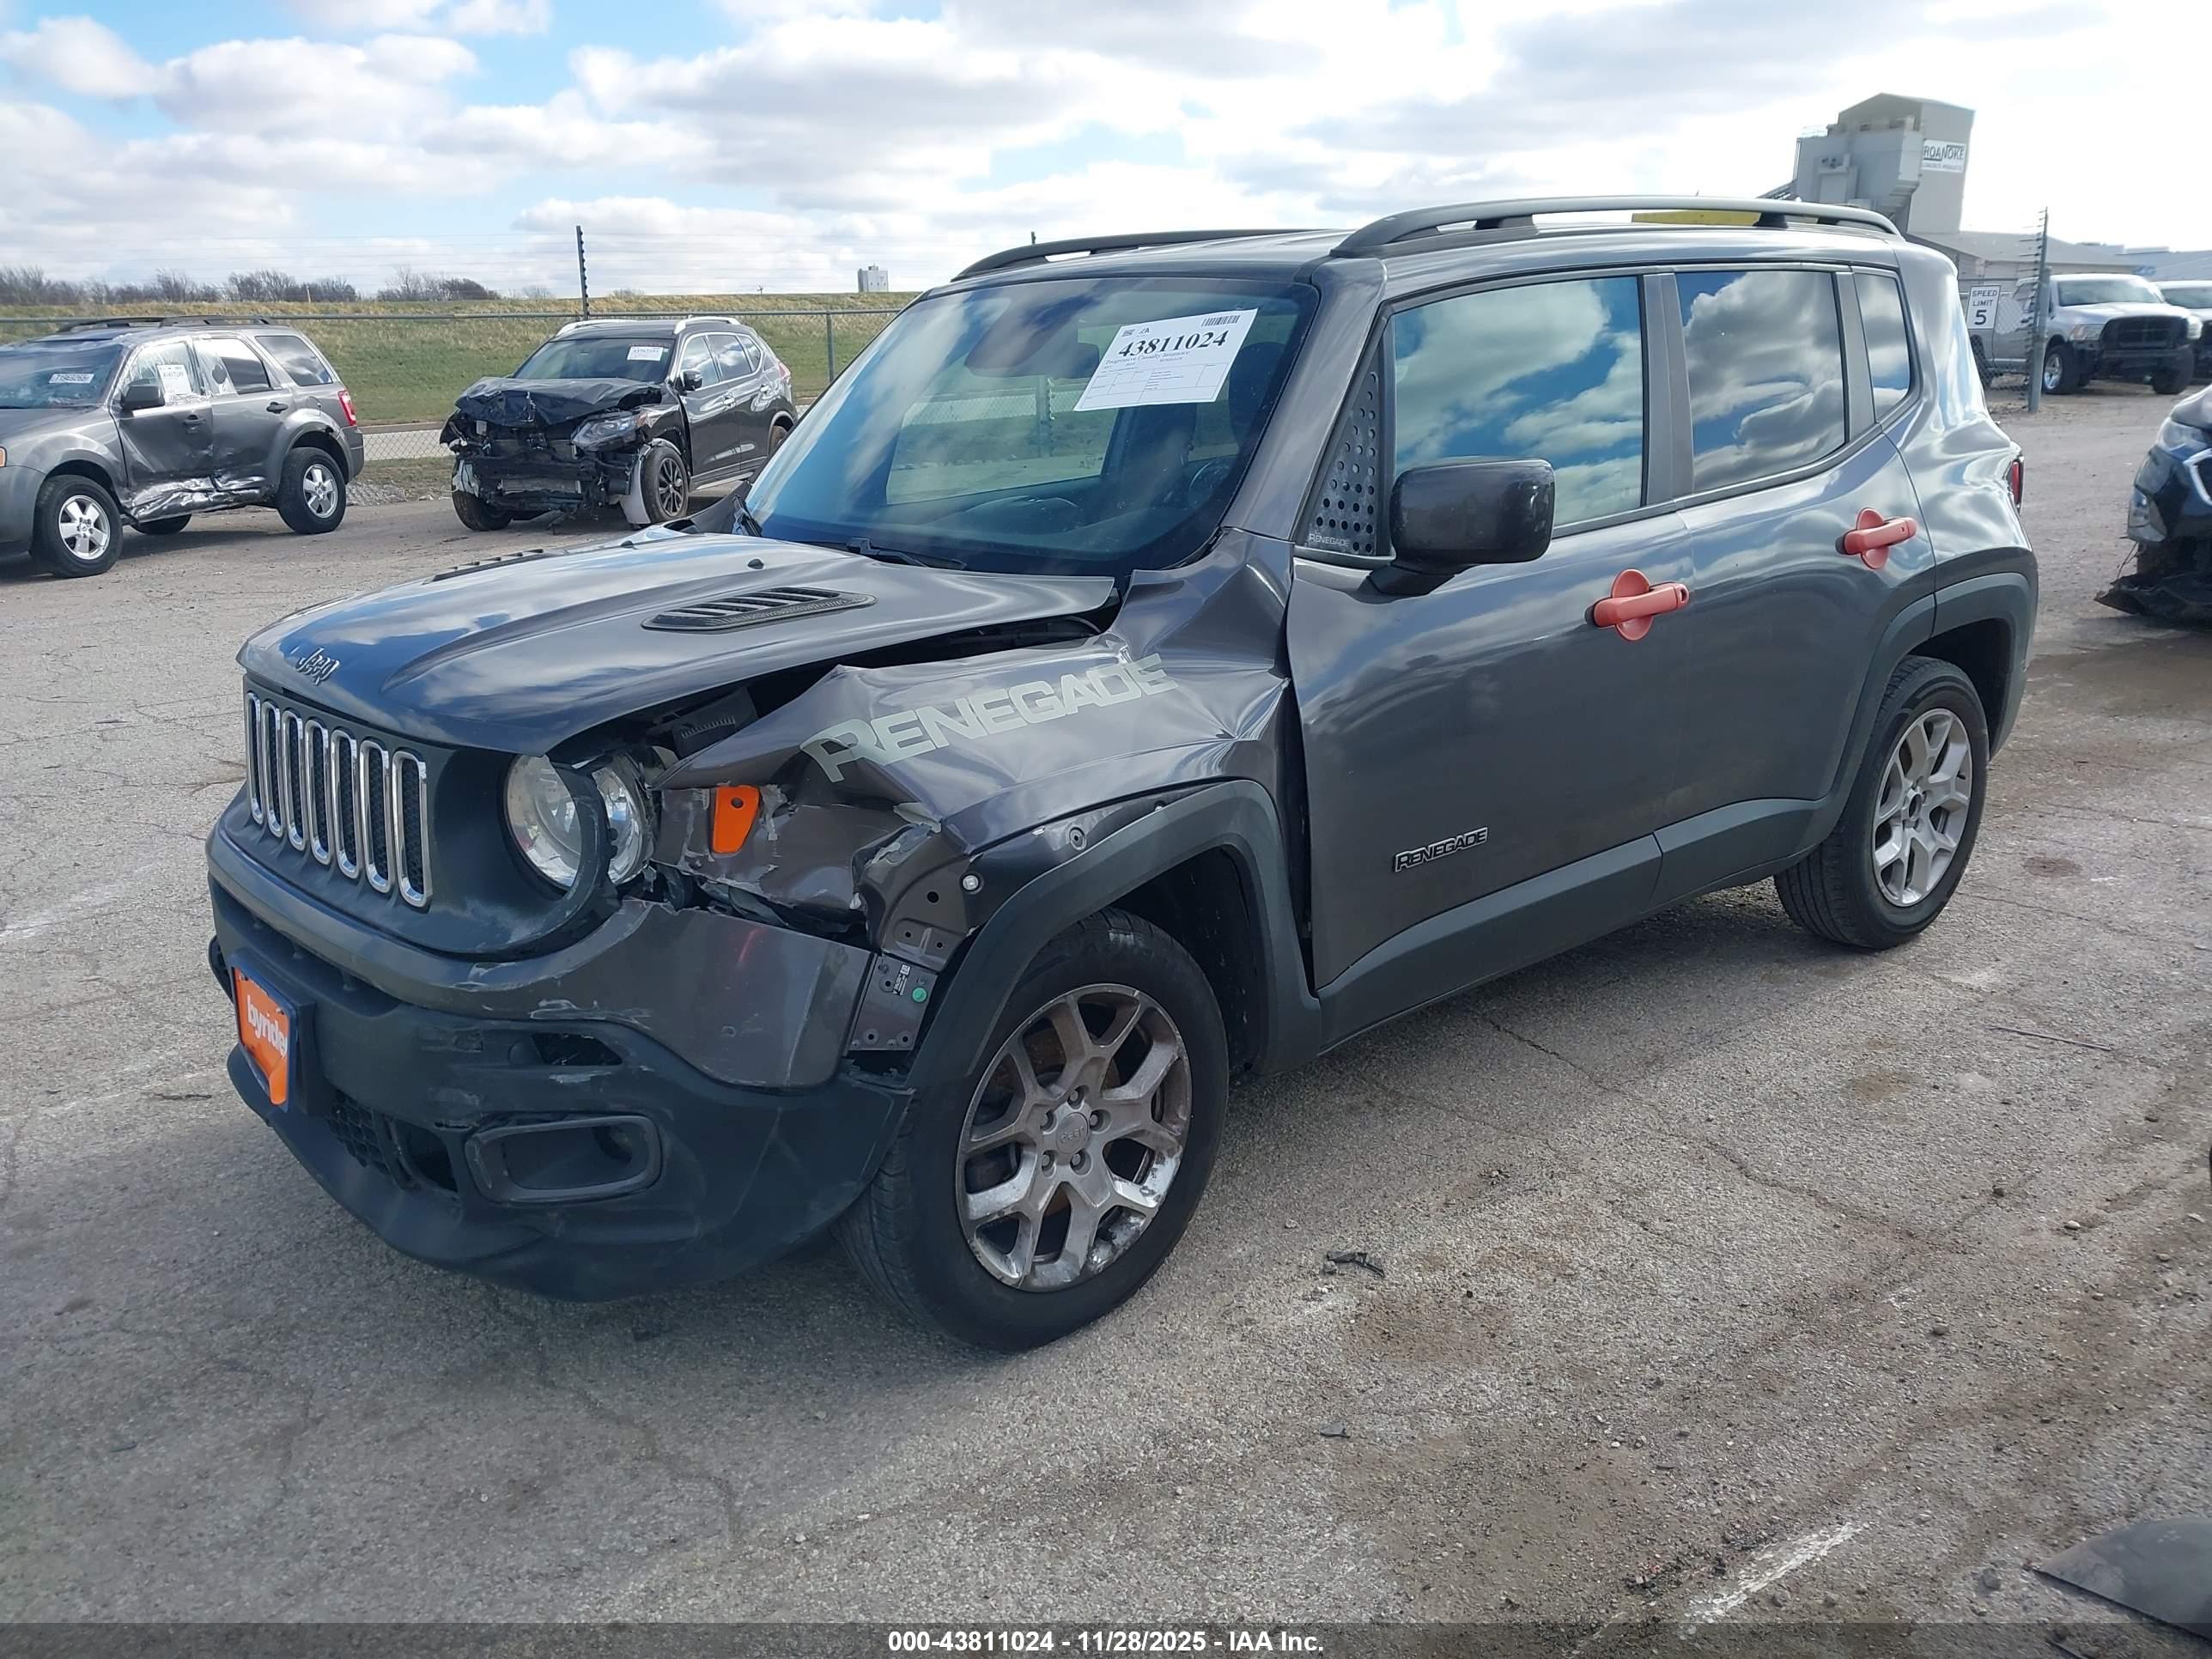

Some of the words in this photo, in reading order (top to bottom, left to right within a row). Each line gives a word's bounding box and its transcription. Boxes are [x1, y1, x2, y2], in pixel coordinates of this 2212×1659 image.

[1923, 145, 1965, 160] ROANOKE
[1974, 309, 1988, 325] 5
[1118, 330, 1230, 357] 43811024
[295, 647, 340, 686] Jeep
[799, 653, 1182, 783] RENEGADE
[1394, 826, 1489, 872] RENEGADE
